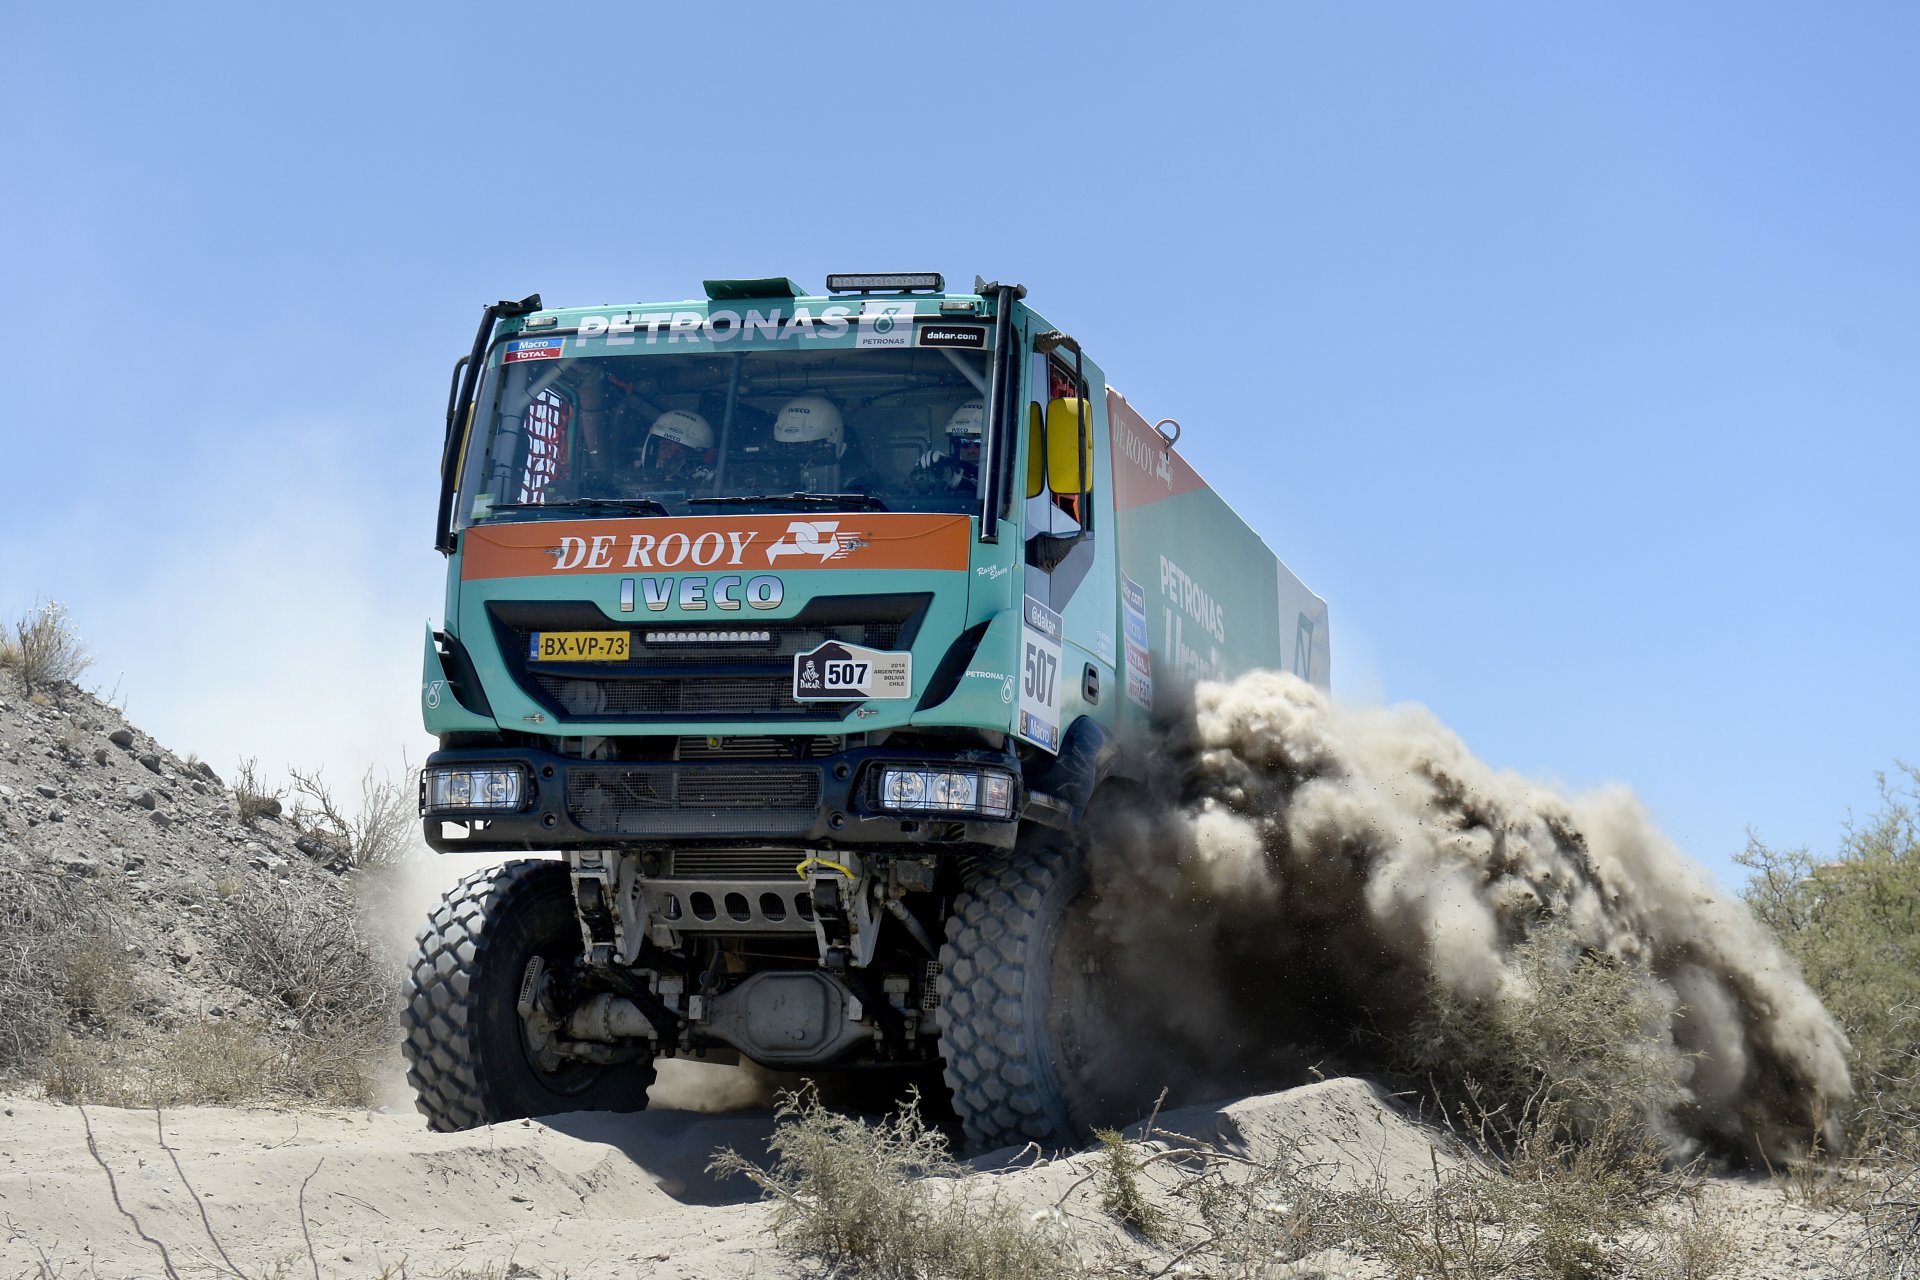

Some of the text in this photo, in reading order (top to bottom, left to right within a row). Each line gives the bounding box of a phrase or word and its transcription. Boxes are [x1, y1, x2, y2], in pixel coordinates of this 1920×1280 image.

[576, 305, 851, 347] PETRONAS
[927, 331, 978, 341] dakar.com
[516, 351, 548, 359] TOTAL
[519, 341, 549, 350] Macro
[1113, 412, 1155, 477] DE ROOY
[552, 531, 758, 570] DE ROOY
[619, 575, 785, 612] IVECO
[1160, 553, 1225, 645] PETRONAS
[1031, 606, 1056, 635] @dakar
[544, 637, 625, 656] BX-VP-73
[800, 680, 820, 689] DAKAR
[828, 664, 868, 685] 507
[966, 670, 1004, 680] PETRONAS
[1025, 641, 1057, 707] 507
[1030, 719, 1050, 743] Macro
